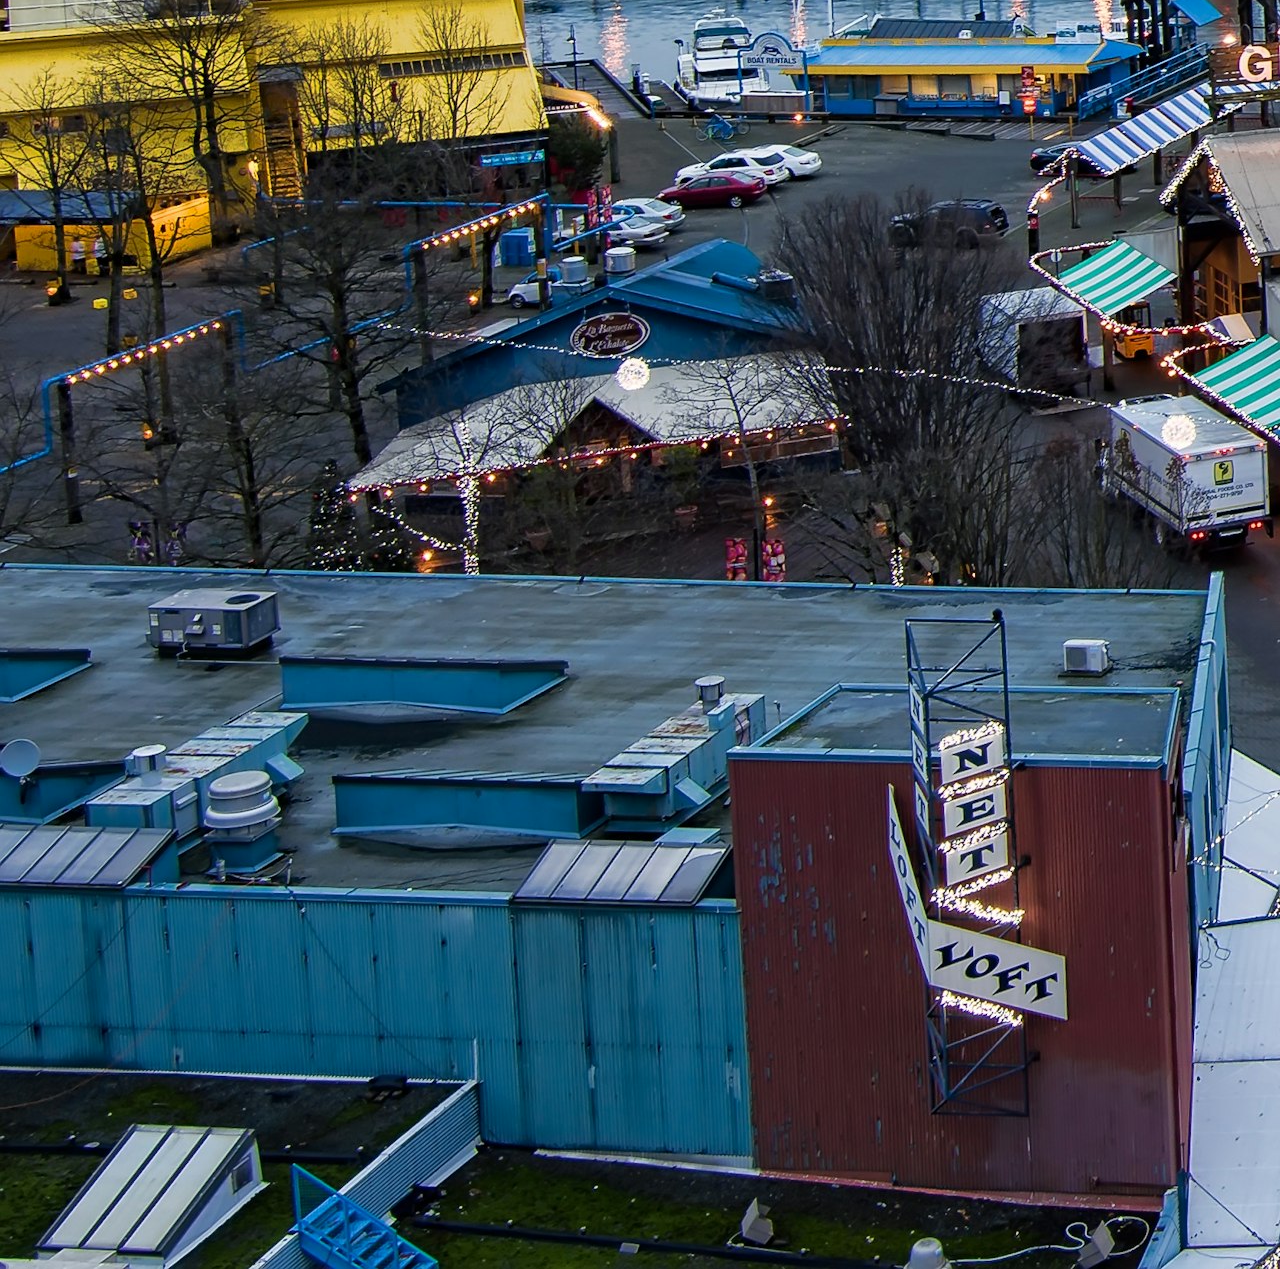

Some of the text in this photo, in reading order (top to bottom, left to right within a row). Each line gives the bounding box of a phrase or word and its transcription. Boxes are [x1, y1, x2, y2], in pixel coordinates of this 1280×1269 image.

[952, 740, 995, 875] NET
[890, 822, 926, 948] LOFT
[935, 941, 1059, 1004] LOFT
